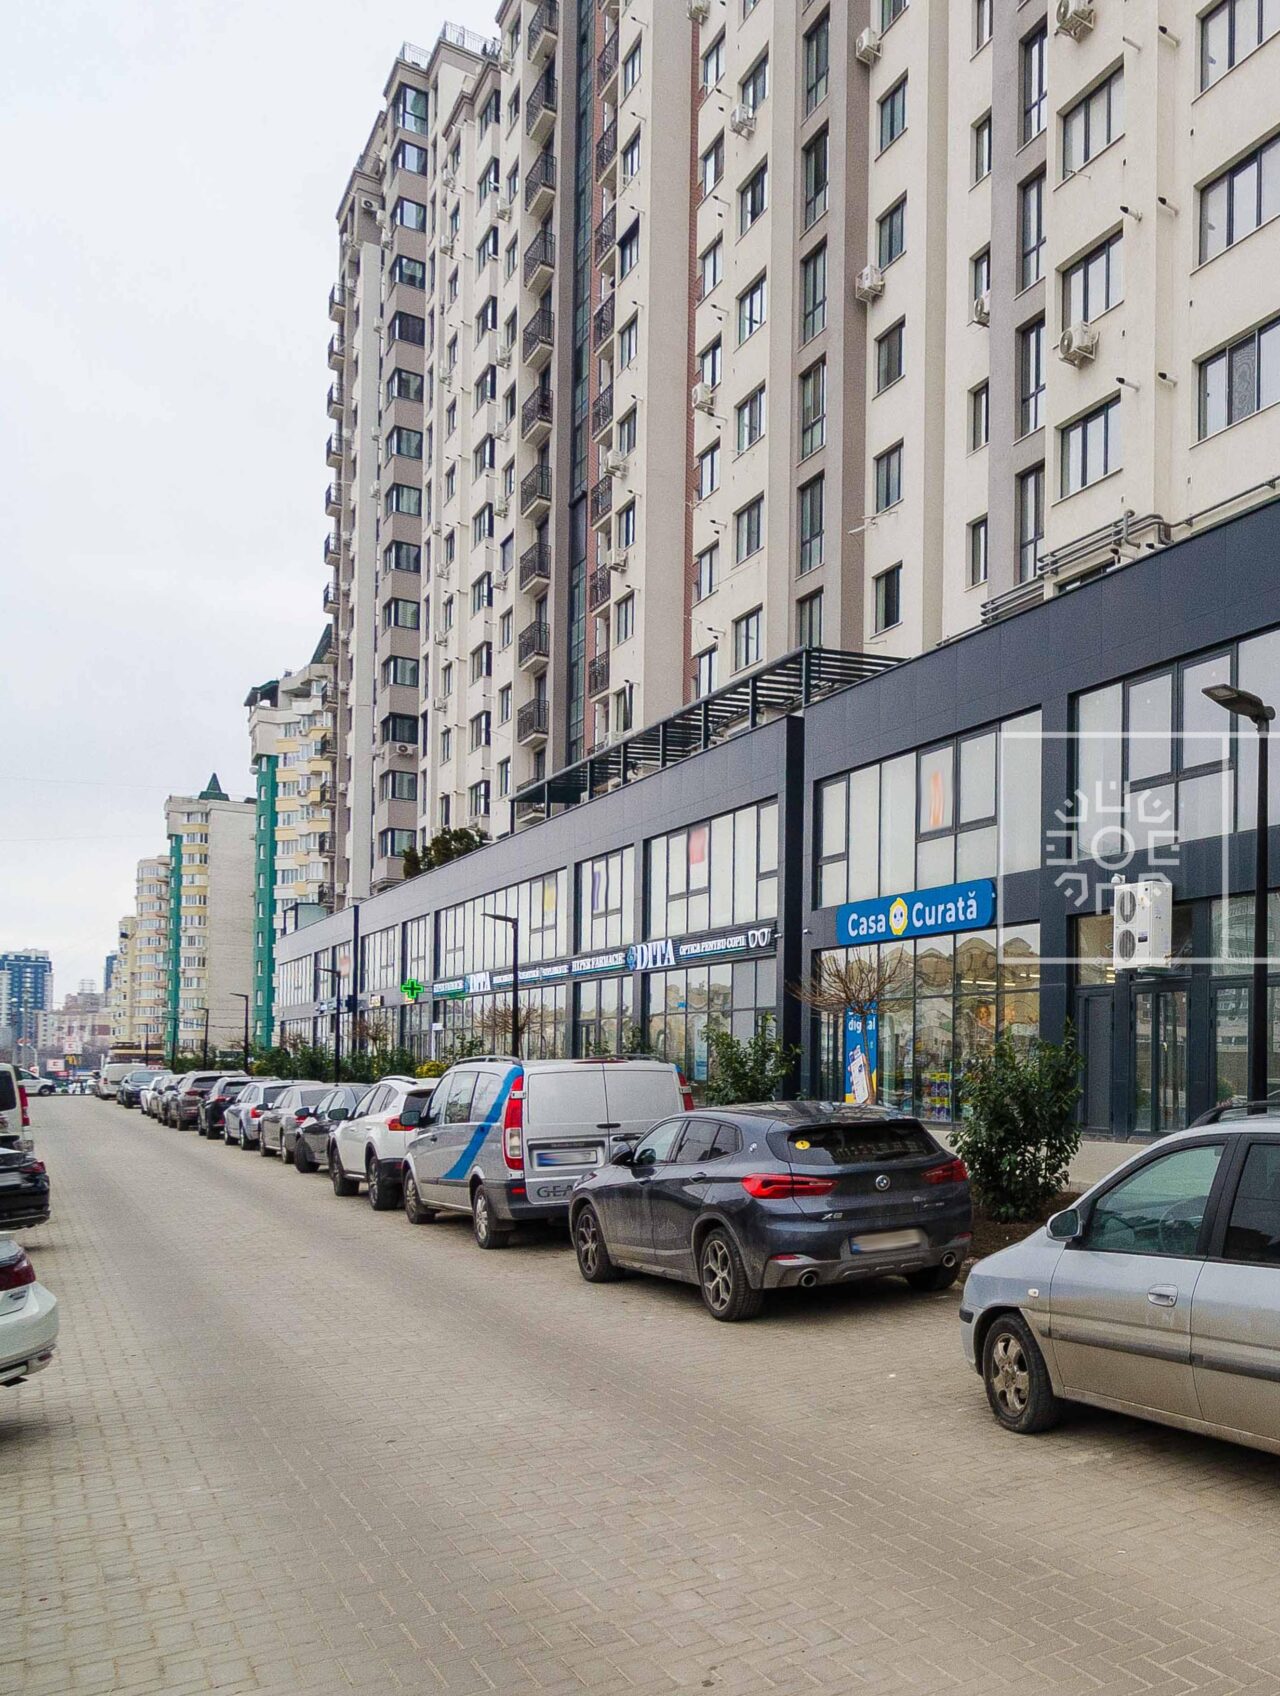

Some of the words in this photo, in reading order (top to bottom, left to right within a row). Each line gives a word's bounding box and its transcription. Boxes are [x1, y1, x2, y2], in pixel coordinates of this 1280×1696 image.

[847, 912, 886, 937] Casa
[911, 890, 978, 928] Curată
[635, 938, 677, 971] DITA
[848, 1017, 876, 1034] digal
